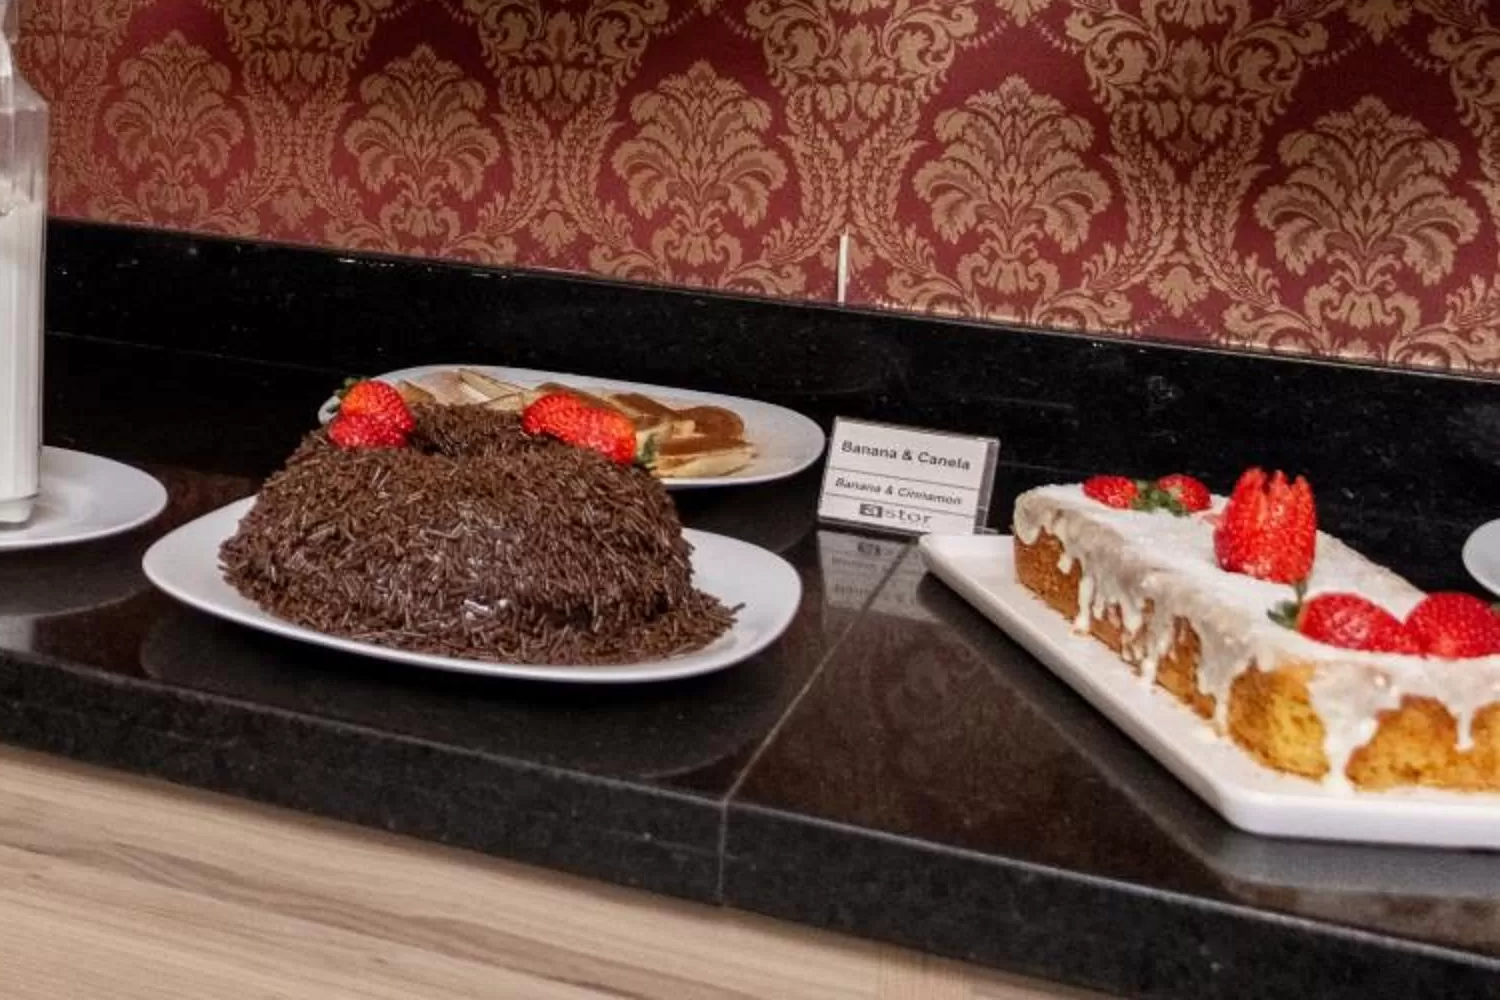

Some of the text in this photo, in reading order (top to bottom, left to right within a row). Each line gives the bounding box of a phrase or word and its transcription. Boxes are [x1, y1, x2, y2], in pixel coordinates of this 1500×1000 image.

[841, 440, 971, 471] Banana & Canela
[835, 477, 881, 494] Banana
[885, 485, 894, 496] &
